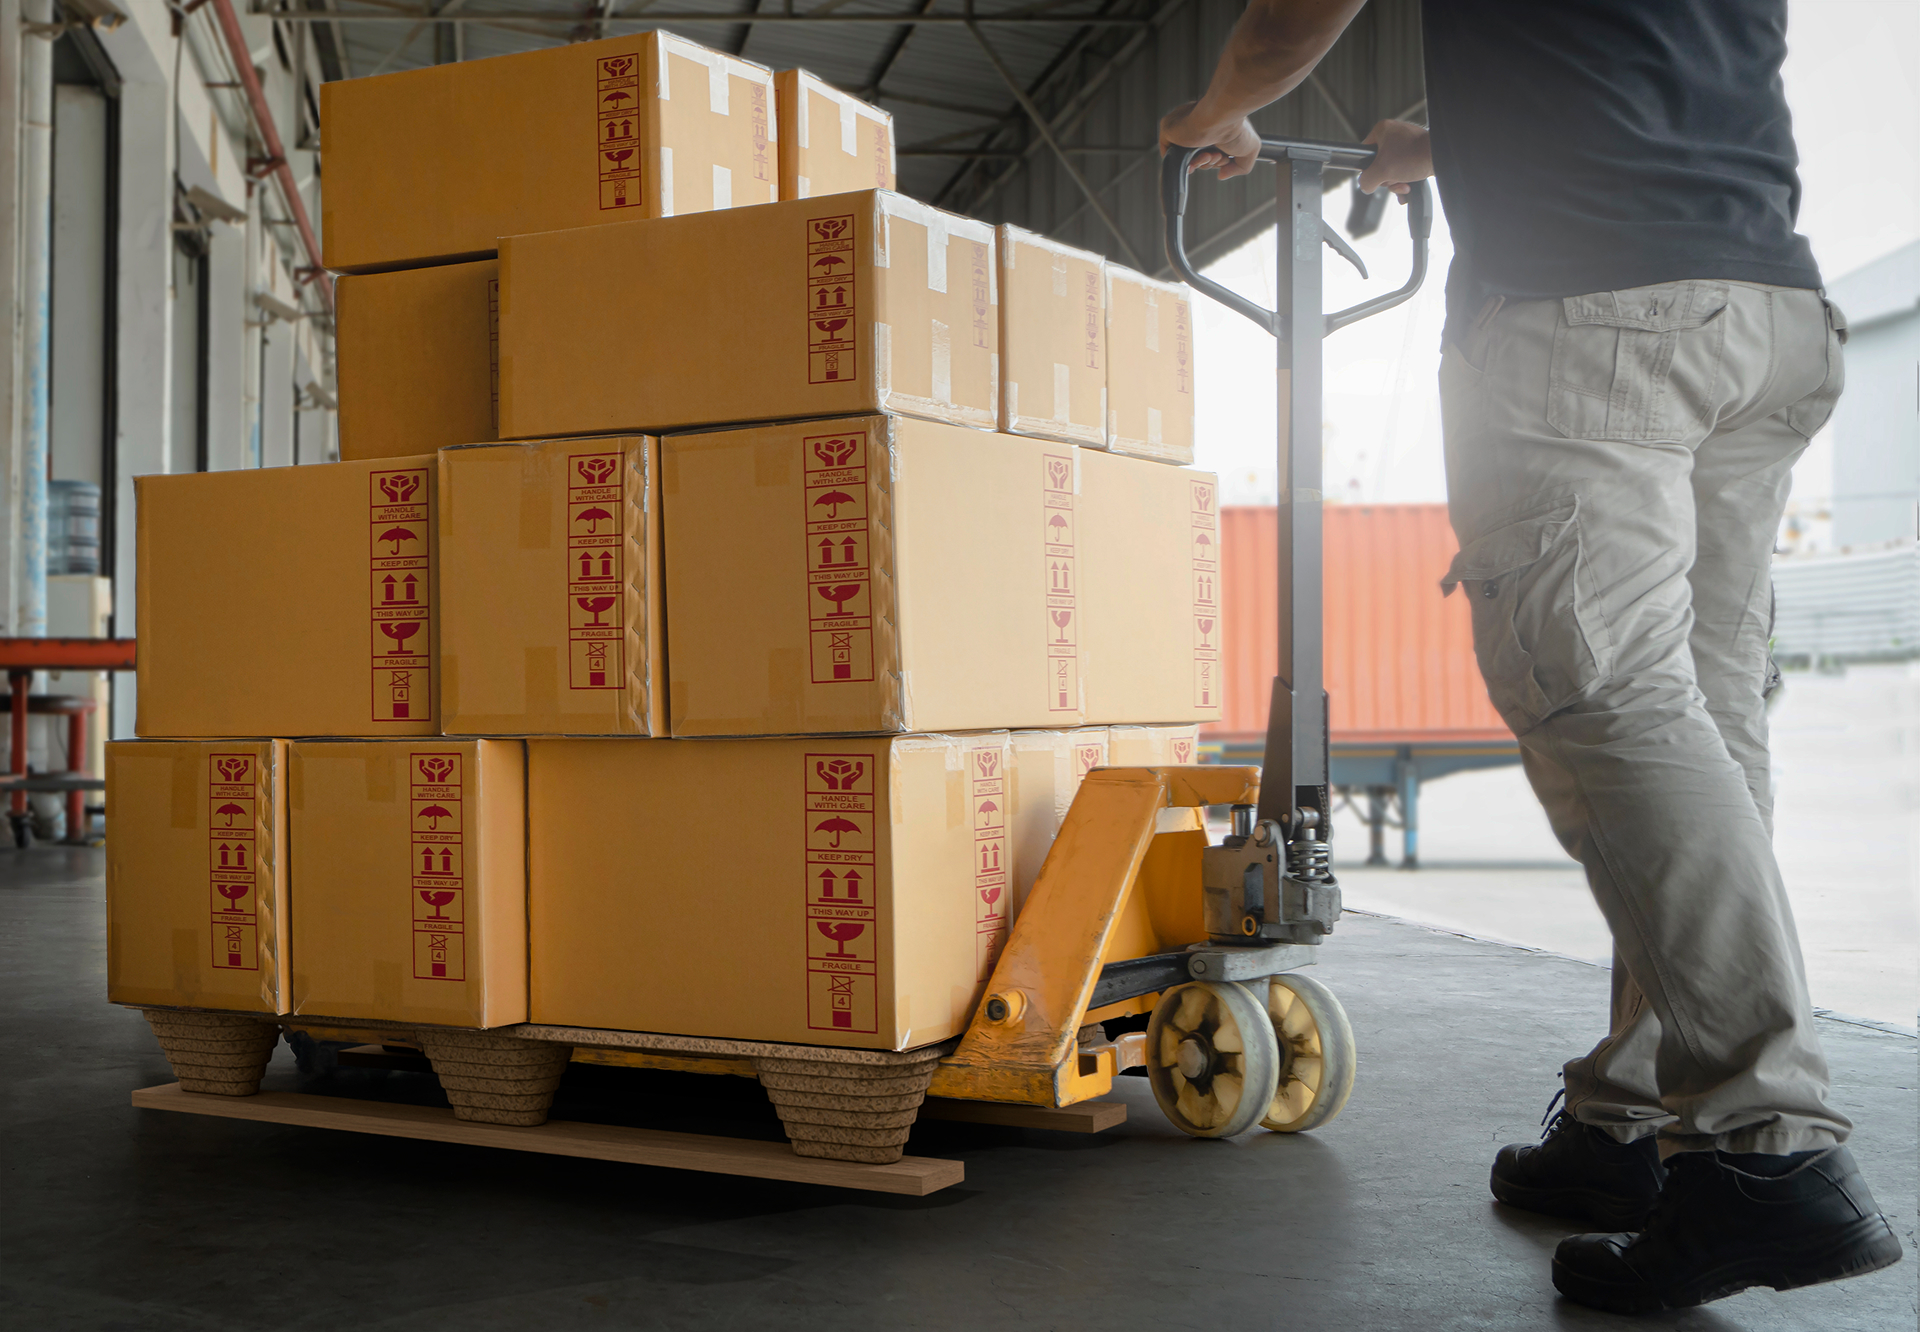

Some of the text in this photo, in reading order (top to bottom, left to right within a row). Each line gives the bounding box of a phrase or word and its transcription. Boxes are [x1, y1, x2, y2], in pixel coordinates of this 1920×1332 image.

[818, 470, 852, 478] HANDLE
[384, 506, 415, 514] HANDLE
[823, 620, 858, 628] FRAGILE
[838, 652, 845, 660] 4
[594, 660, 600, 668] 4
[397, 690, 404, 698] 4
[844, 854, 863, 862] DRY
[812, 908, 833, 916] THIS
[834, 908, 855, 916] WAY
[436, 952, 442, 960] 4
[822, 962, 862, 970] FRAGILE
[838, 996, 846, 1006] 4
